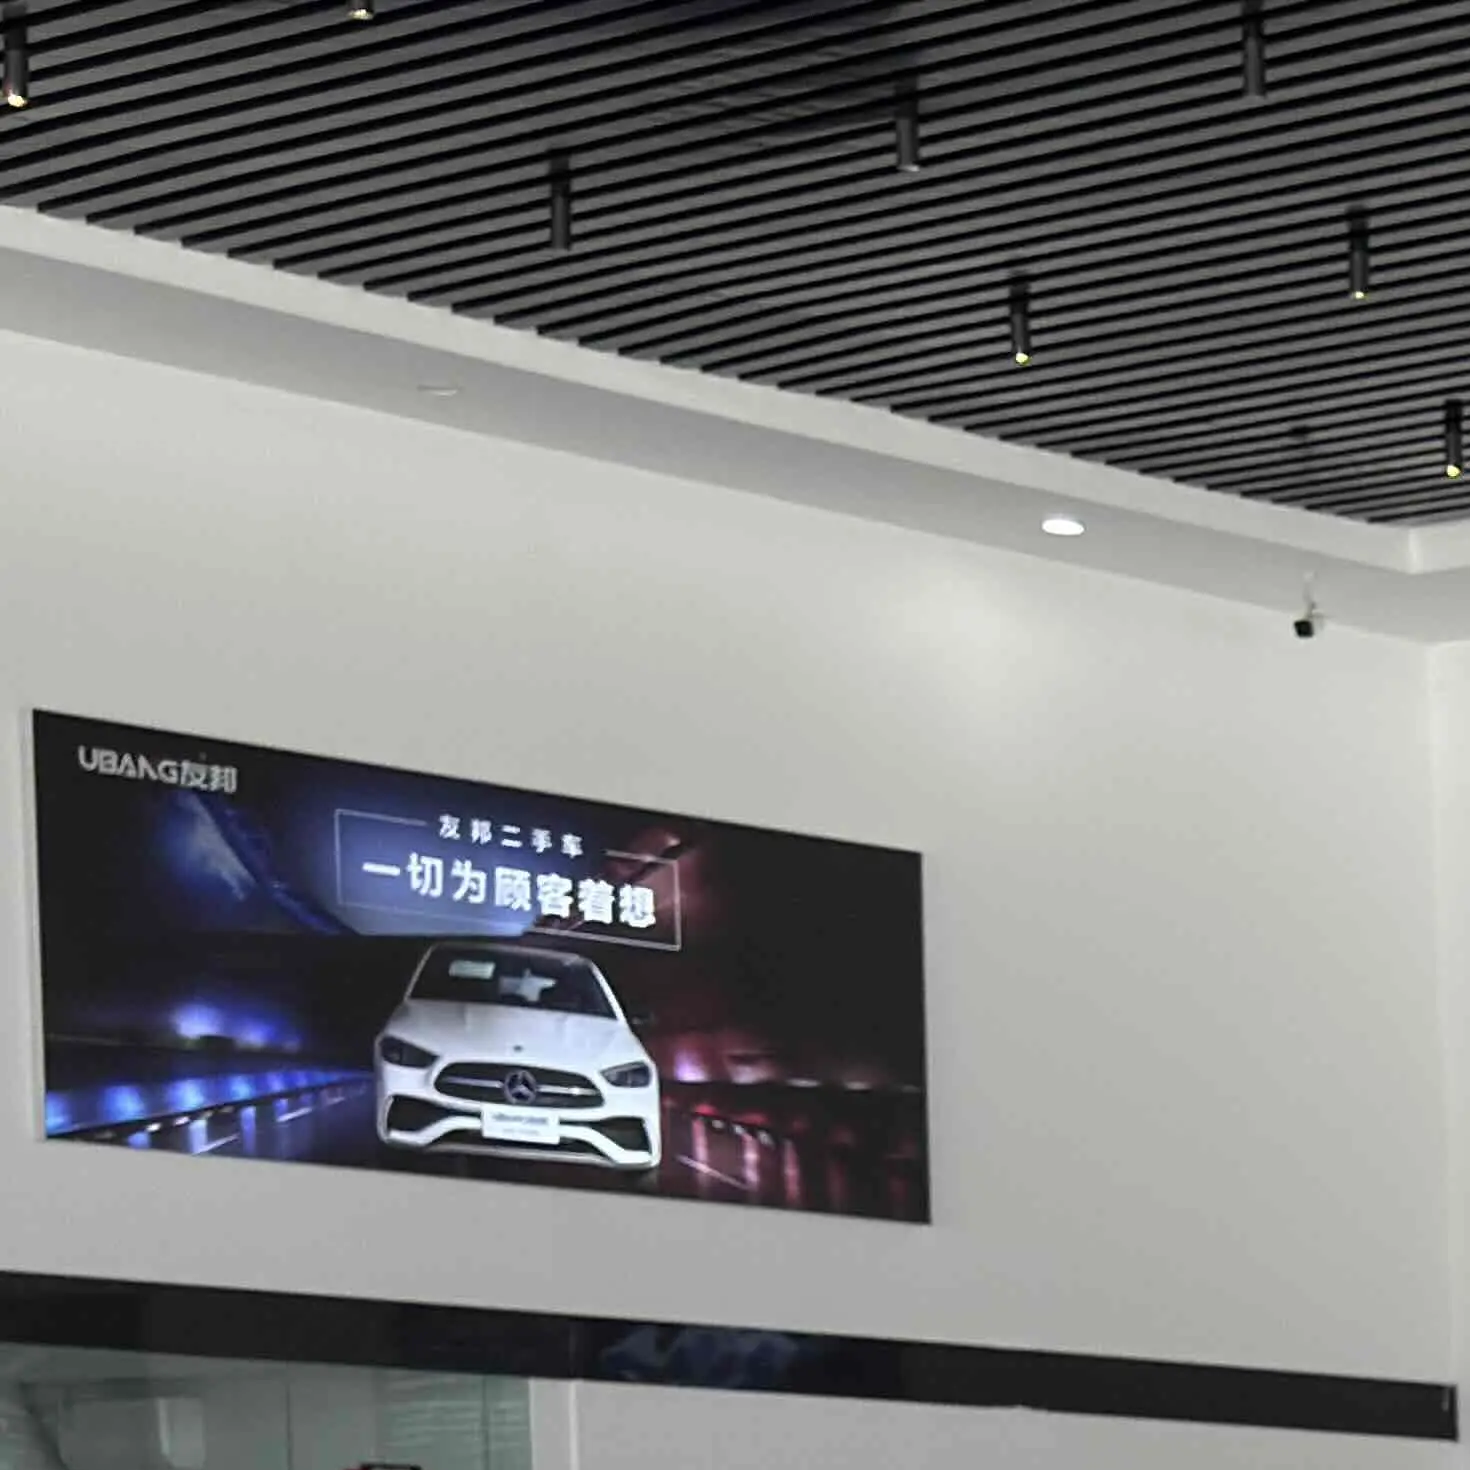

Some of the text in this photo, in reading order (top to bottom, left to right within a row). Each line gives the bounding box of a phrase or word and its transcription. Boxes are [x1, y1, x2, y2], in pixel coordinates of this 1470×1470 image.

[438, 813, 584, 858] 友邦二手车
[362, 851, 656, 928] 一切为顾客着想
